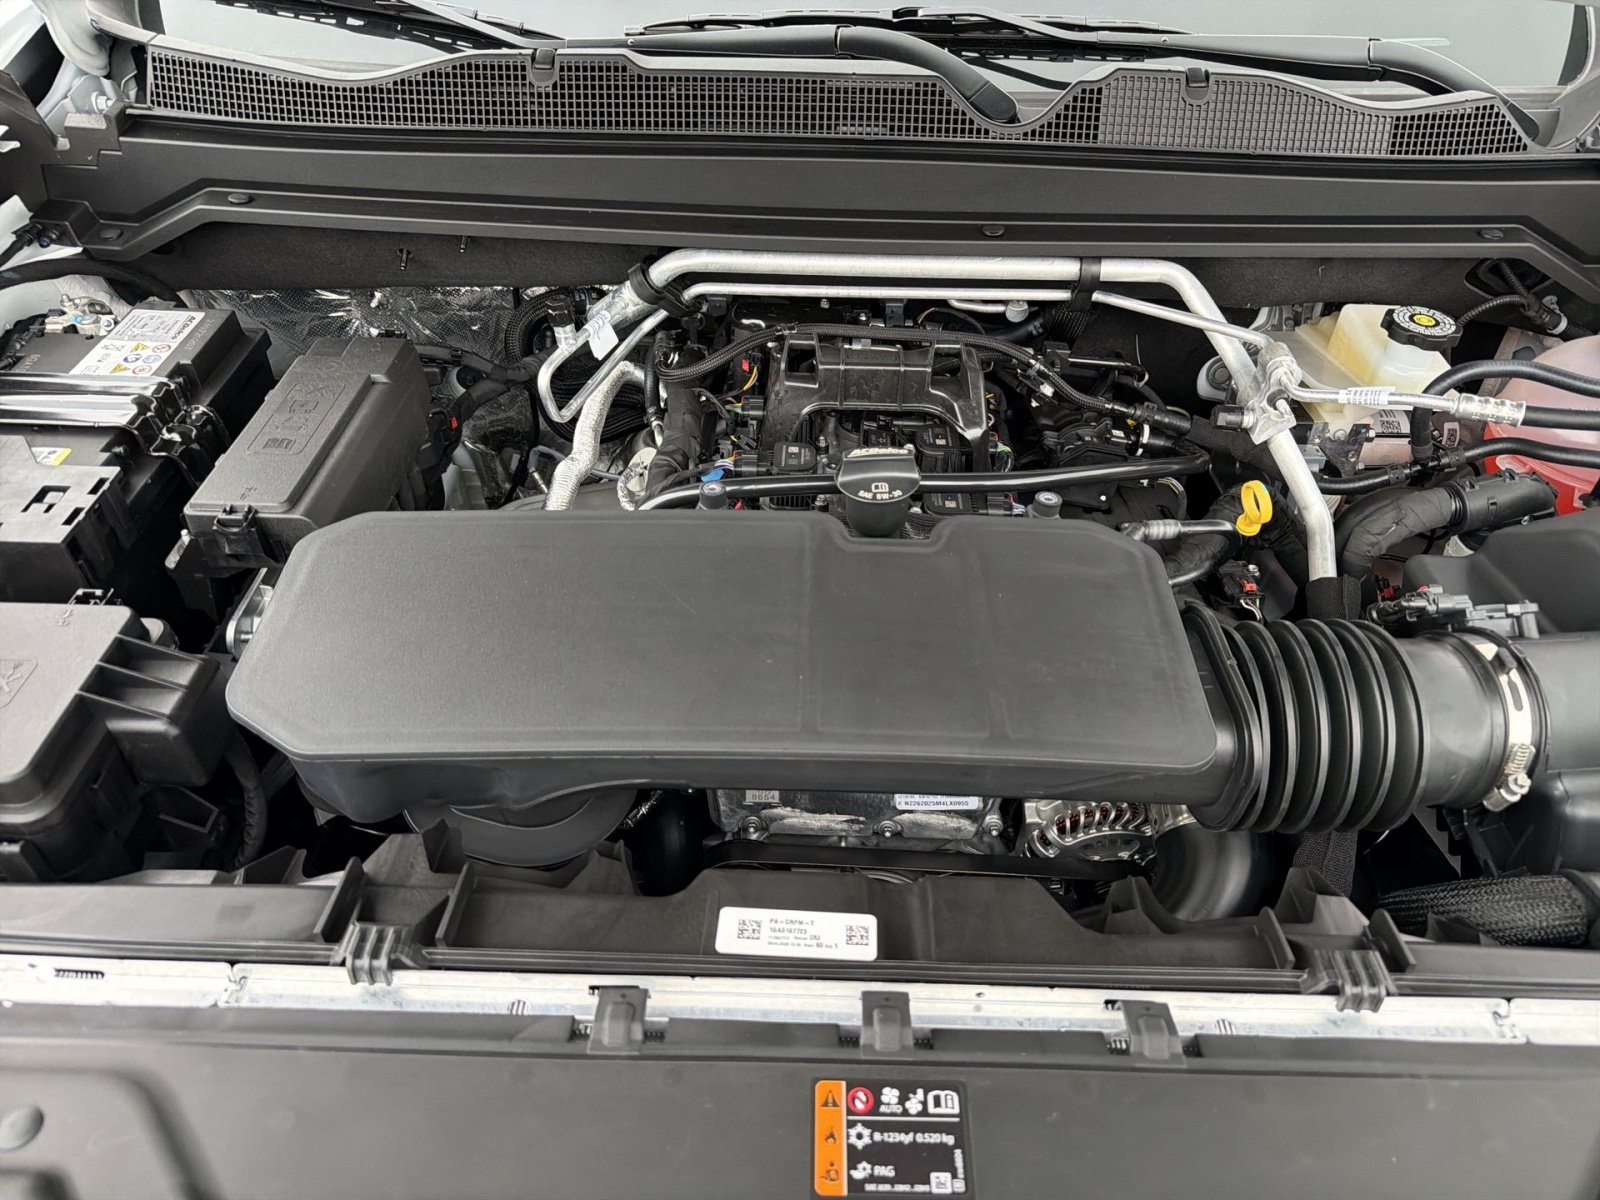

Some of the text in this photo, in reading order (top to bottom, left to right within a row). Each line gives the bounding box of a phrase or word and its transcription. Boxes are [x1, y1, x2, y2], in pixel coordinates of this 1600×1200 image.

[847, 447, 908, 458] ACDelco
[858, 490, 902, 500] SAE 5W-30
[879, 1104, 903, 1113] AUTO
[873, 1132, 955, 1146] R-1234yf 0.520 kg
[873, 1165, 896, 1178] PAG
